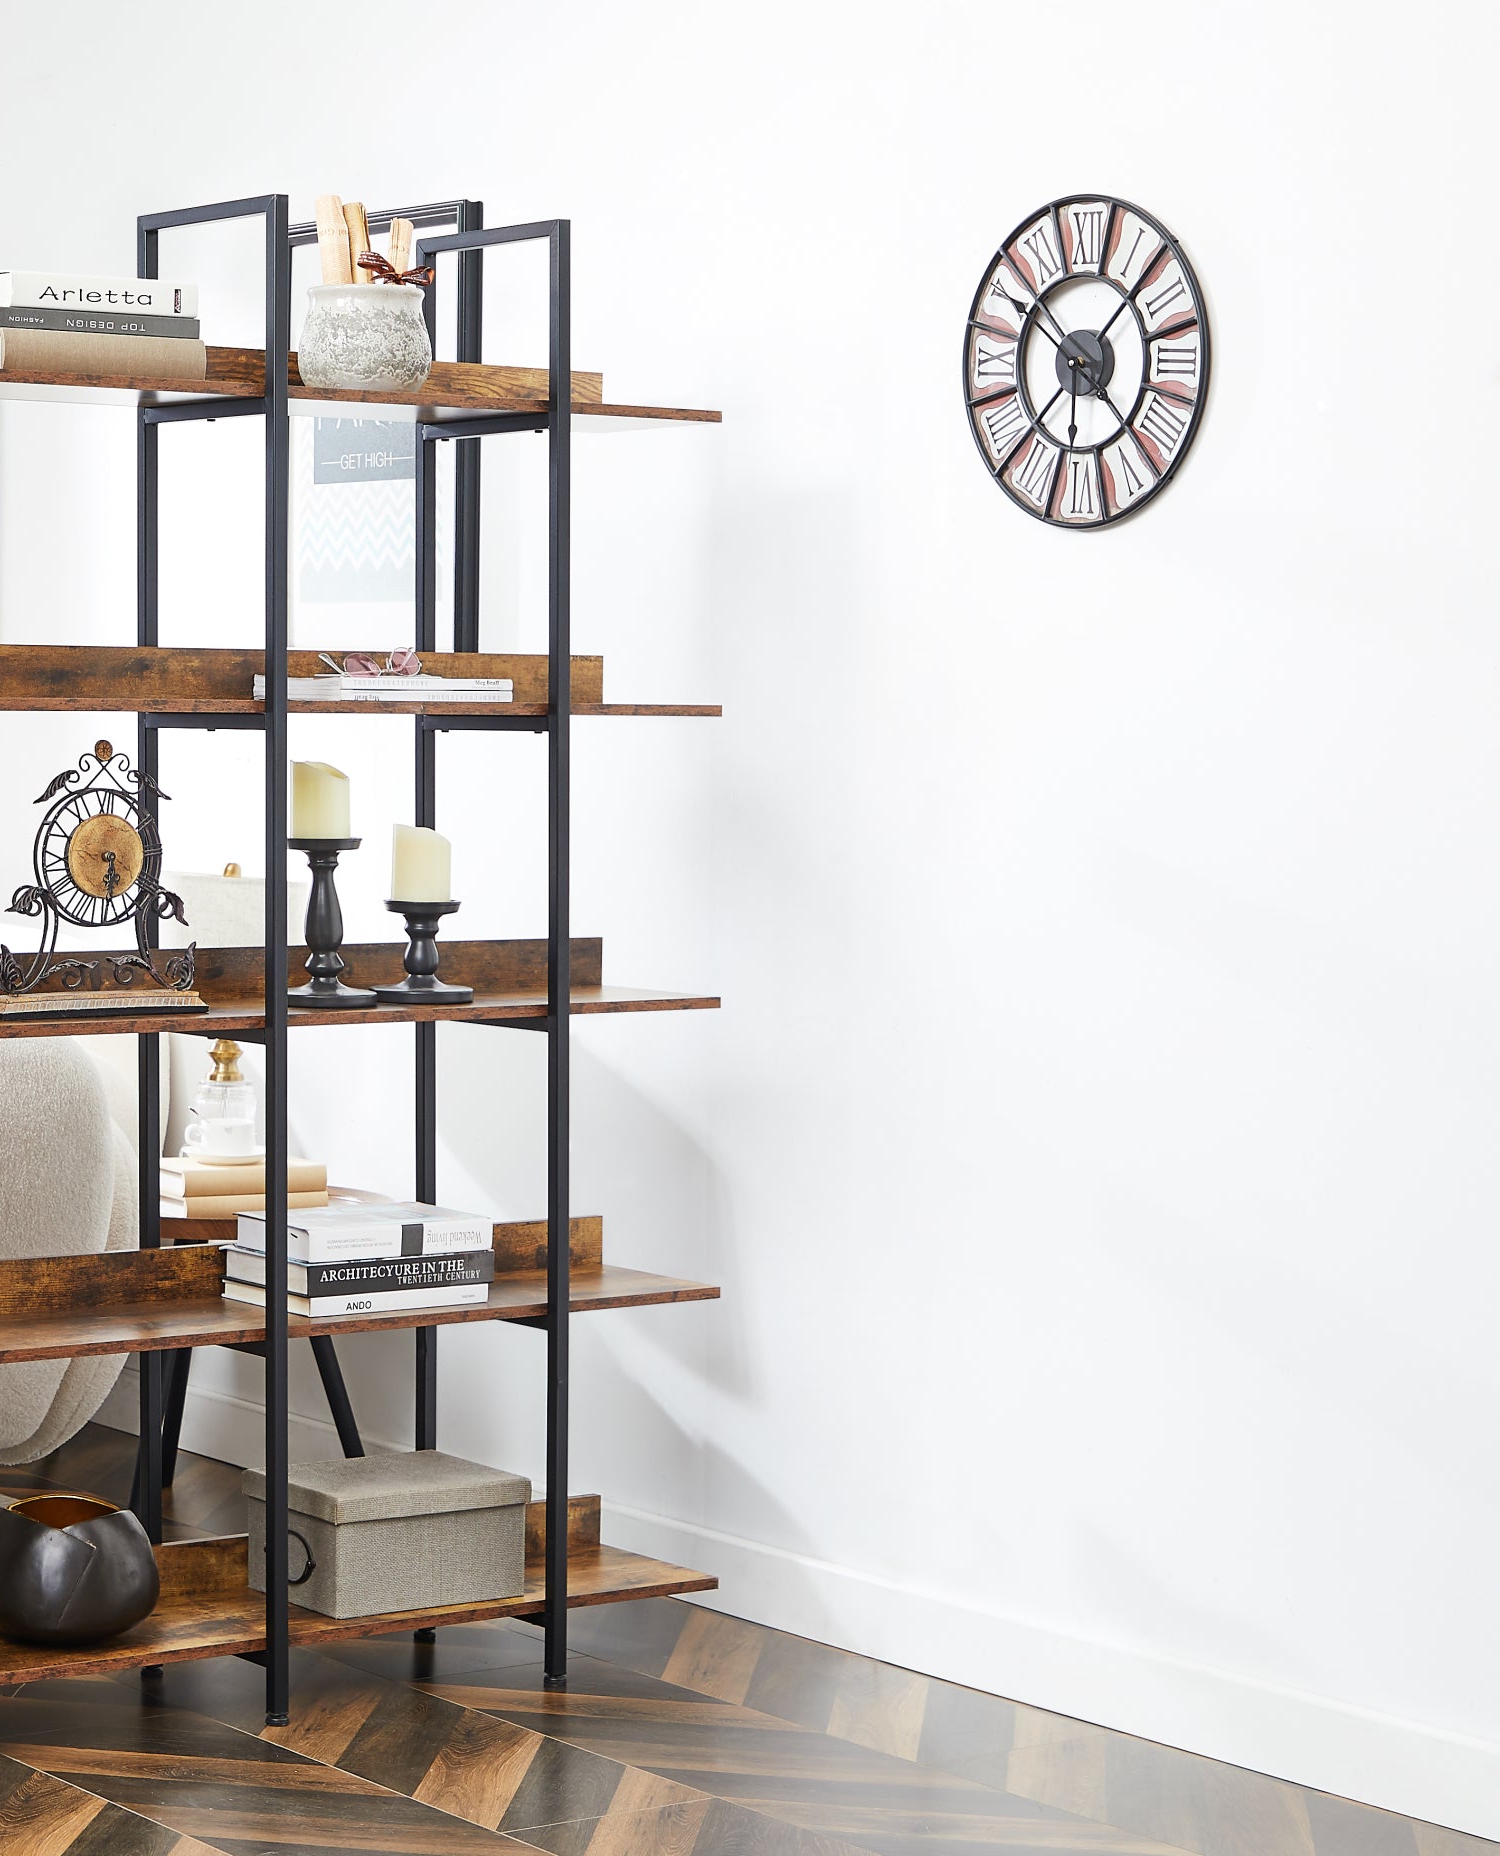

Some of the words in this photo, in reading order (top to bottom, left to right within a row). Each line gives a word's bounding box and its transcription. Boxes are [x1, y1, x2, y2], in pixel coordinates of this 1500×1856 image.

[1072, 211, 1104, 265] XII
[1023, 225, 1062, 286] XI
[1120, 227, 1146, 278] I
[39, 285, 153, 306] Arletta
[1145, 276, 1187, 320] II
[9, 316, 44, 324] FASHION
[66, 319, 114, 330] DESIGN
[120, 322, 146, 332] TOP
[977, 346, 1015, 378] IX
[1156, 345, 1197, 378] III
[340, 453, 363, 470] GET
[365, 451, 393, 468] HIGH
[426, 1229, 448, 1247] living
[450, 1230, 483, 1245] Weekend
[320, 1263, 420, 1283] ARCHITECYURE
[422, 1261, 436, 1274] IN
[438, 1259, 465, 1273] THE
[397, 1273, 443, 1285] TWENTIETH
[445, 1269, 481, 1281] CENTURY
[346, 1300, 372, 1312] ANDO
